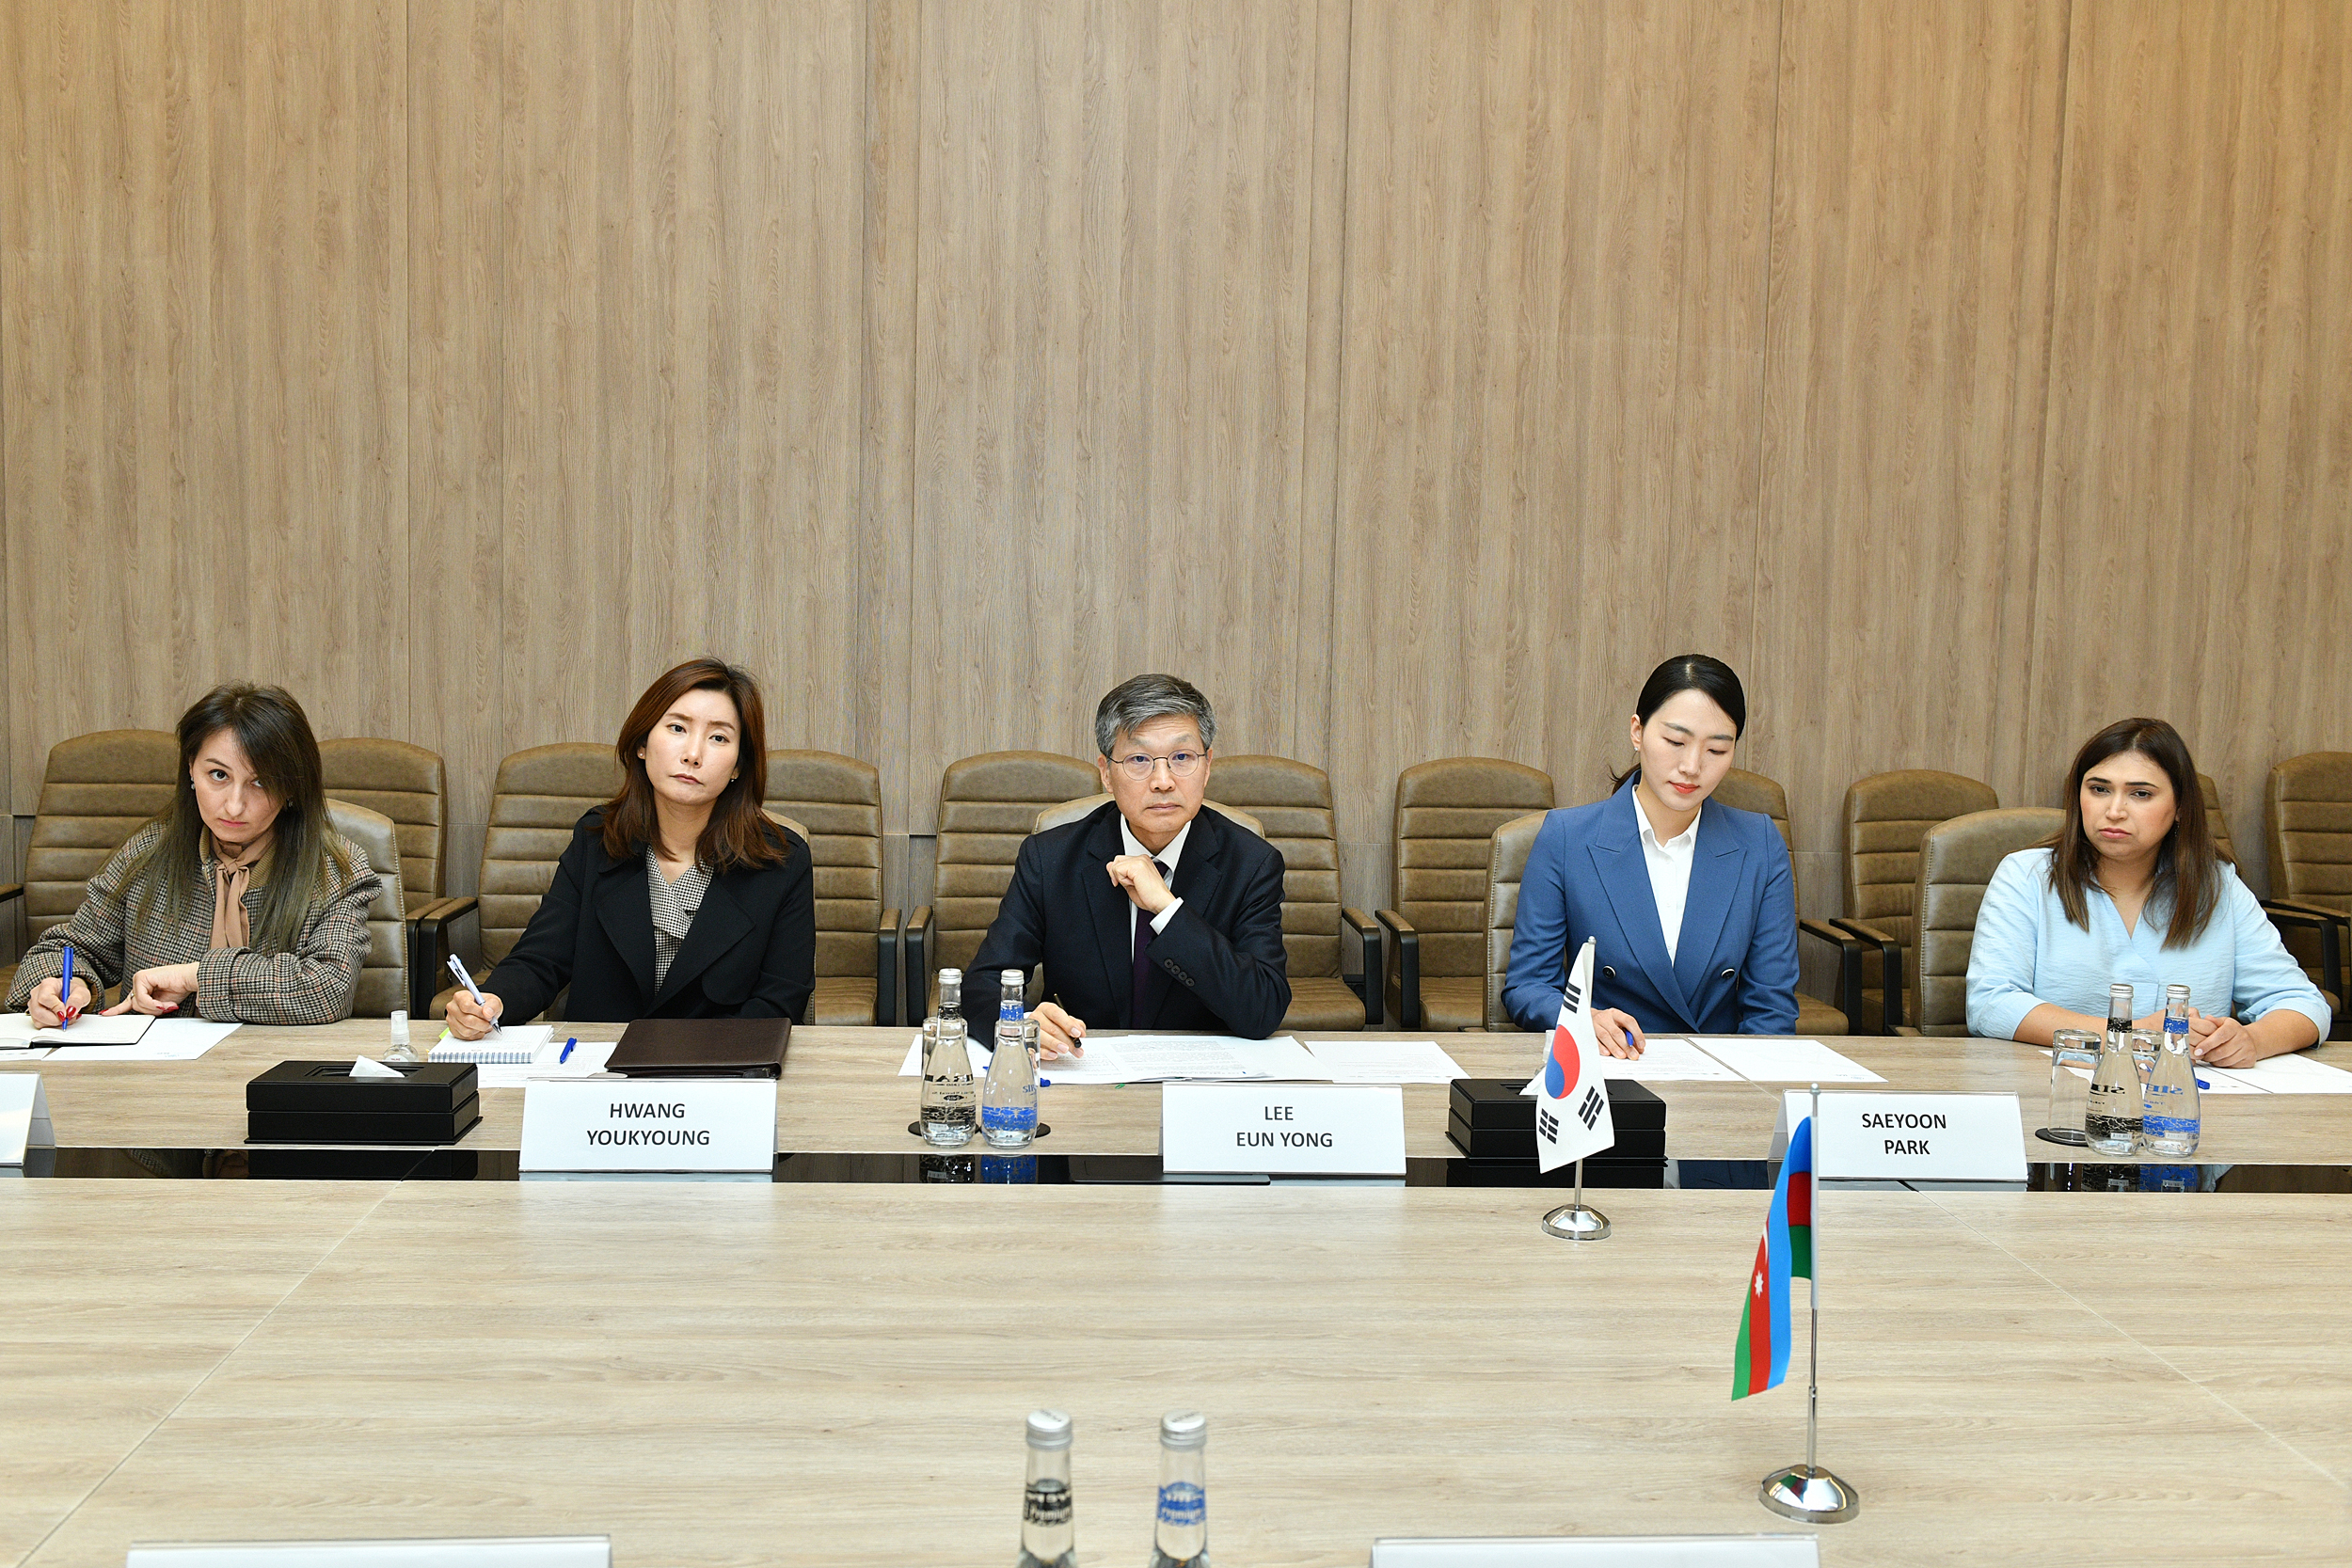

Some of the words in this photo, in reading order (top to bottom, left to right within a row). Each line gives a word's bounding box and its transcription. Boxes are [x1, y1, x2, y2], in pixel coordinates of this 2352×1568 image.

[610, 1102, 686, 1118] HWANG
[1264, 1106, 1294, 1121] LEE
[1861, 1113, 1947, 1130] SAEYOON
[586, 1130, 710, 1146] YOUKYOUNG
[1236, 1132, 1274, 1148] EUN
[1279, 1132, 1333, 1148] YONG
[1883, 1139, 1931, 1155] PARK
